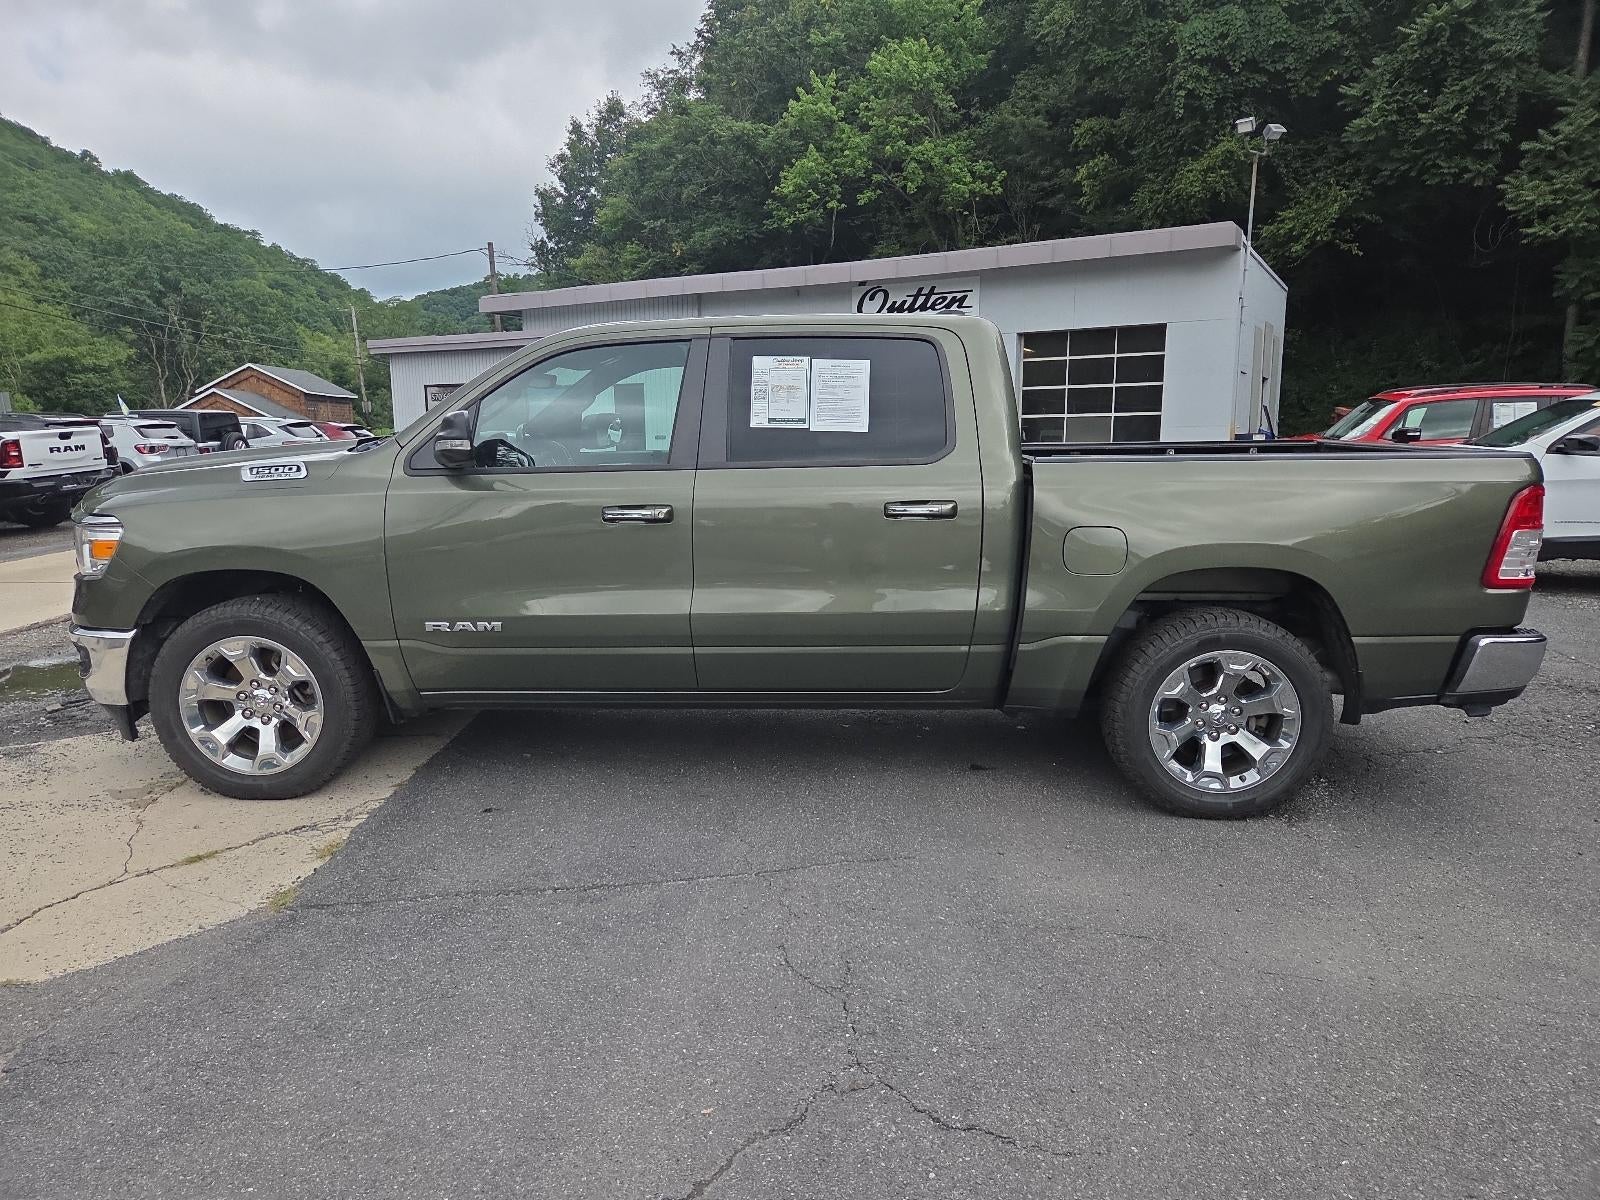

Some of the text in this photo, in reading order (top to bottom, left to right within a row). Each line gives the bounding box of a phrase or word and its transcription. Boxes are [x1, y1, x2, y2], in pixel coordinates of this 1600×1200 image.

[856, 285, 974, 314] Outten
[49, 444, 86, 454] RAM
[250, 465, 299, 475] 1500
[425, 621, 503, 632] RAM
